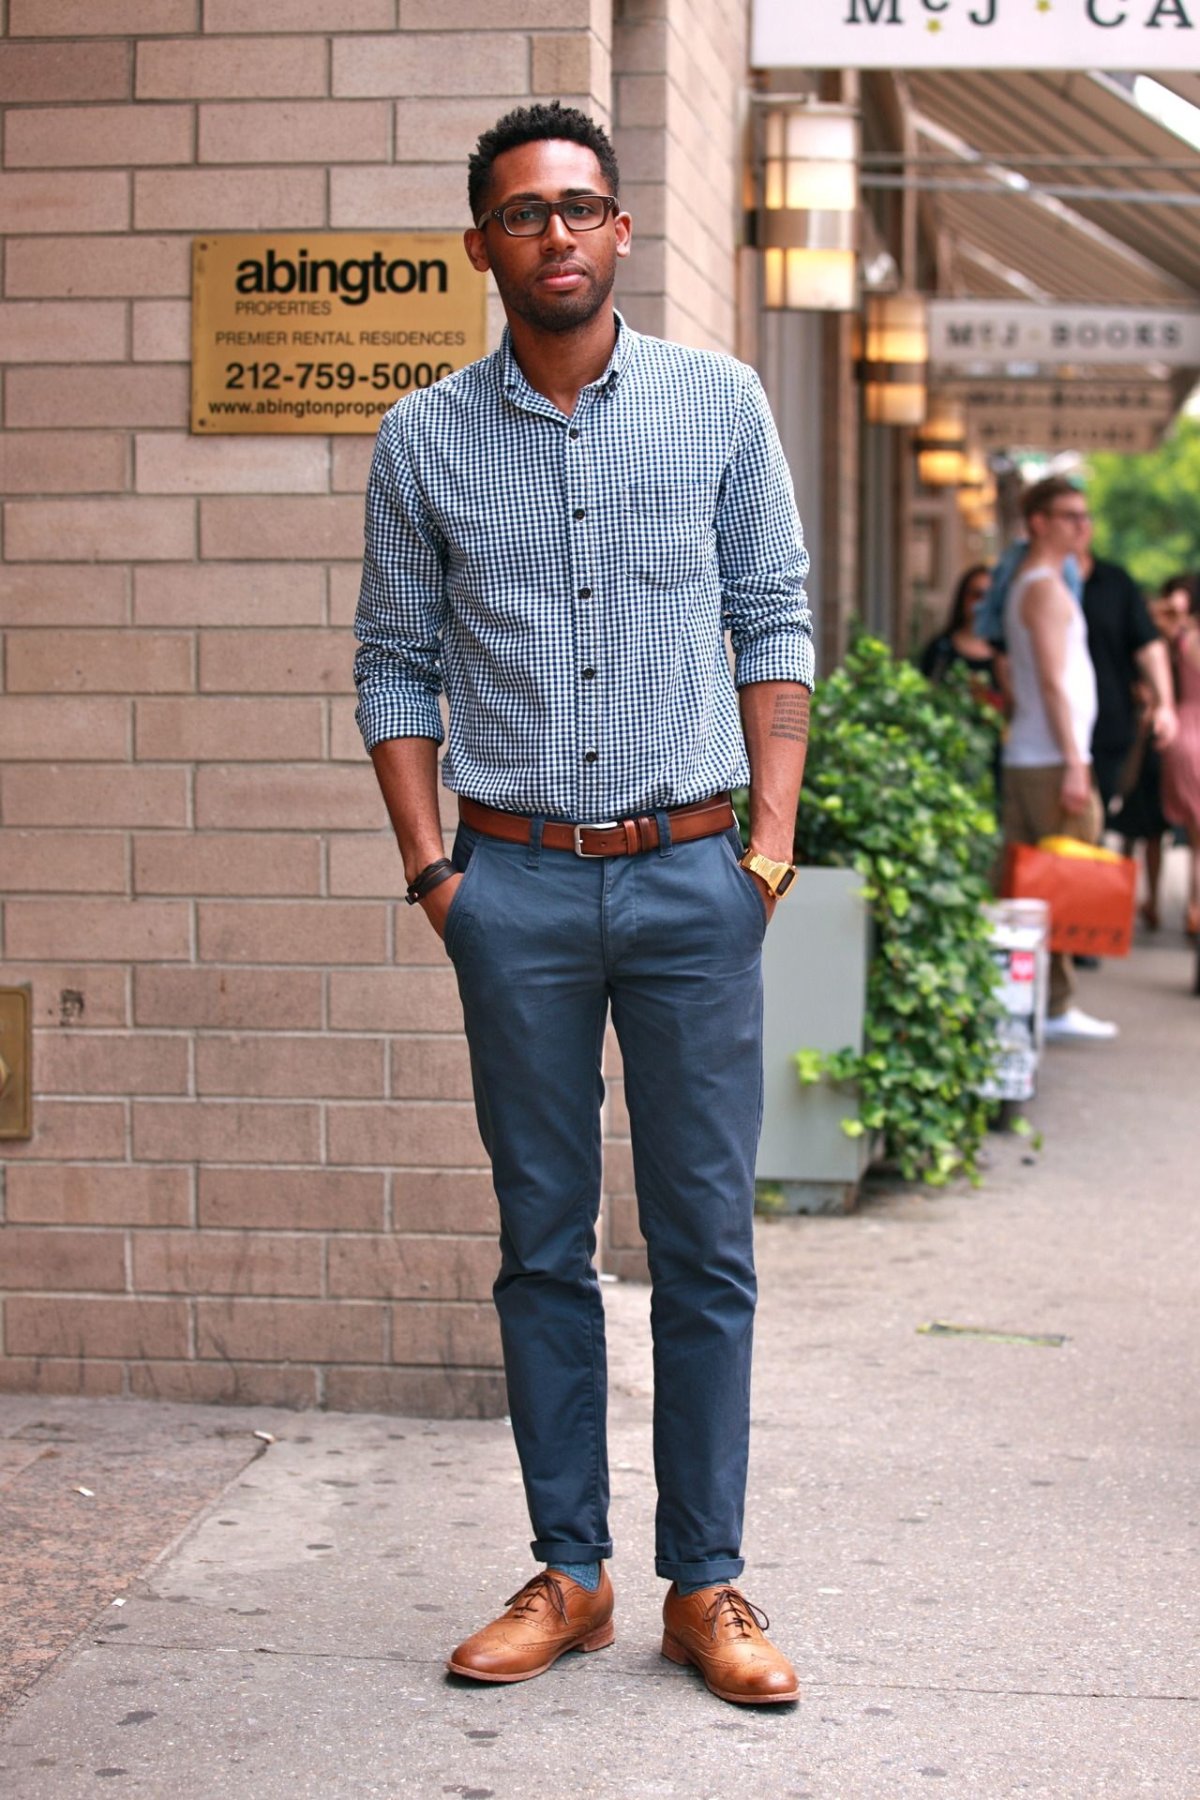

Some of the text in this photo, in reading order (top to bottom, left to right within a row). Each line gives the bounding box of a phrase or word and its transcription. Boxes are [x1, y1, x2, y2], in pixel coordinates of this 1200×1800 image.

[235, 249, 448, 305] abington
[235, 301, 332, 316] PROPERTIES
[215, 331, 466, 346] PREMIER RENTAL RESIDENCES
[1052, 321, 1183, 348] BOOKS
[208, 398, 397, 418] www.abingtonprope
